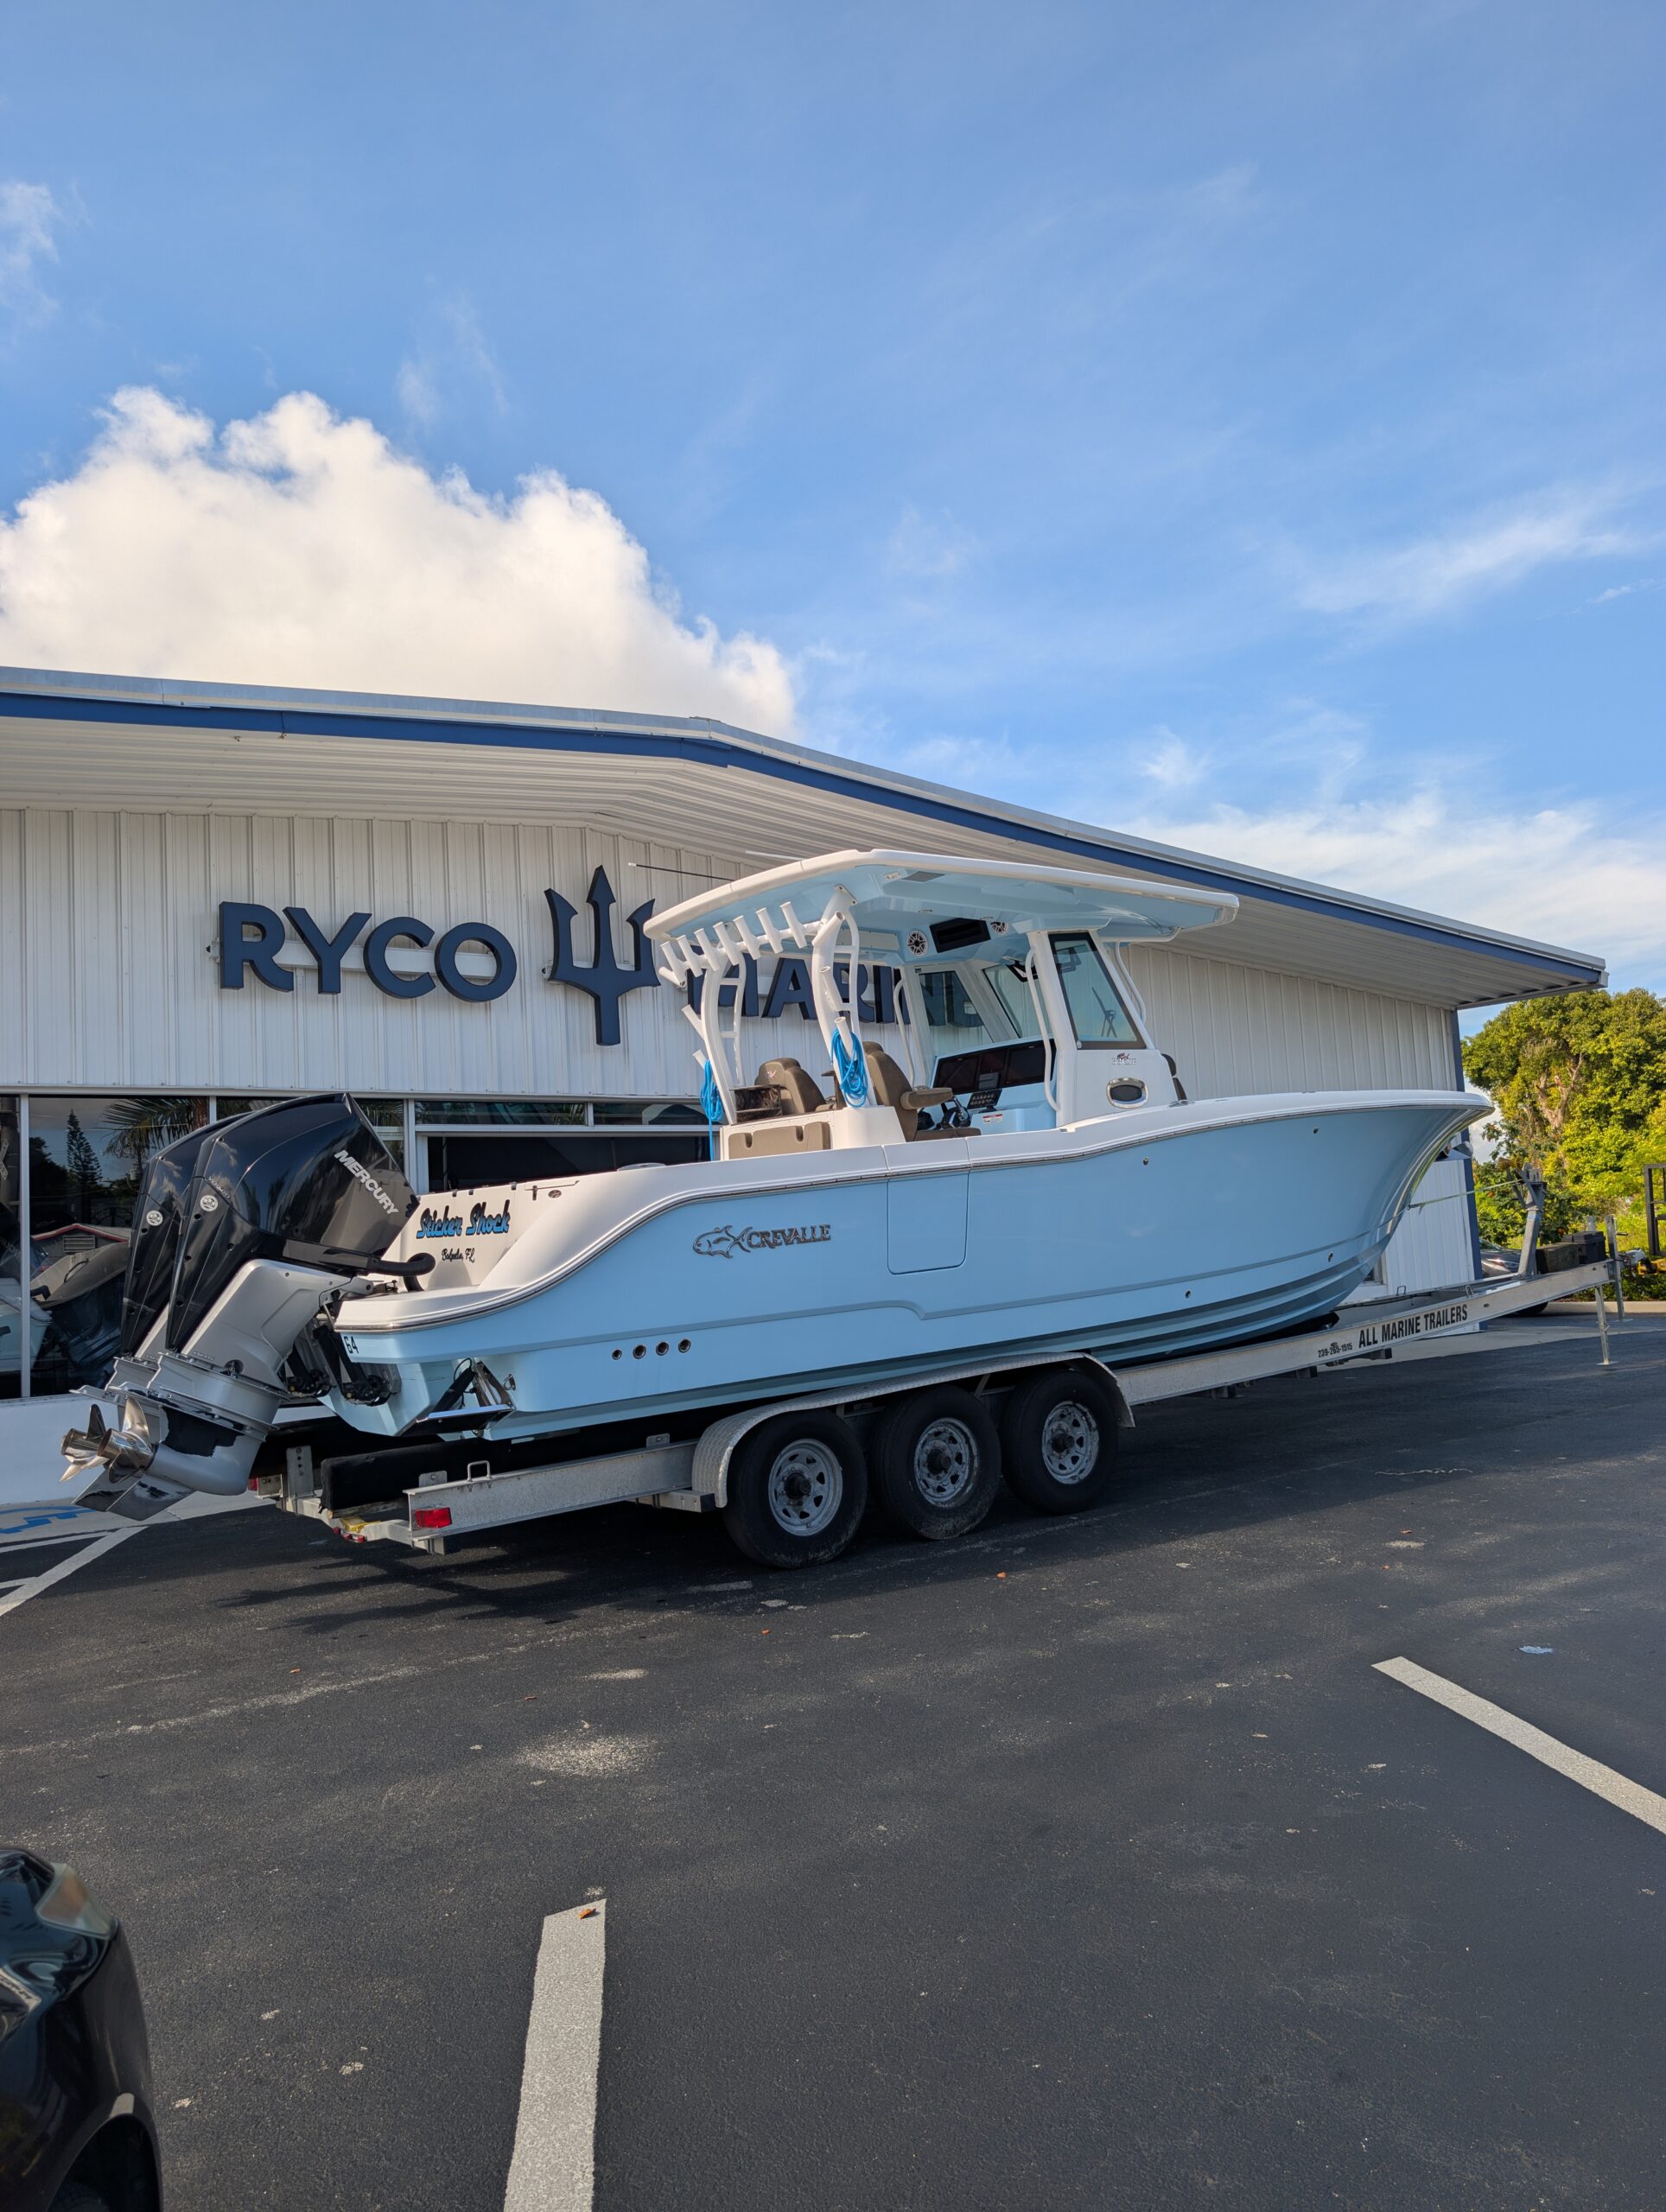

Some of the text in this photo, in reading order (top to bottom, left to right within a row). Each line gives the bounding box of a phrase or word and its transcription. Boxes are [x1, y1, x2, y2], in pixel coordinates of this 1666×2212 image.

[219, 901, 518, 1002] RYCO
[334, 1149, 399, 1215] MERCURY
[416, 1199, 511, 1239] Sticker Shock
[746, 1224, 831, 1249] CREVALLE
[1358, 1304, 1467, 1348] ALL MARINE TRAILERS
